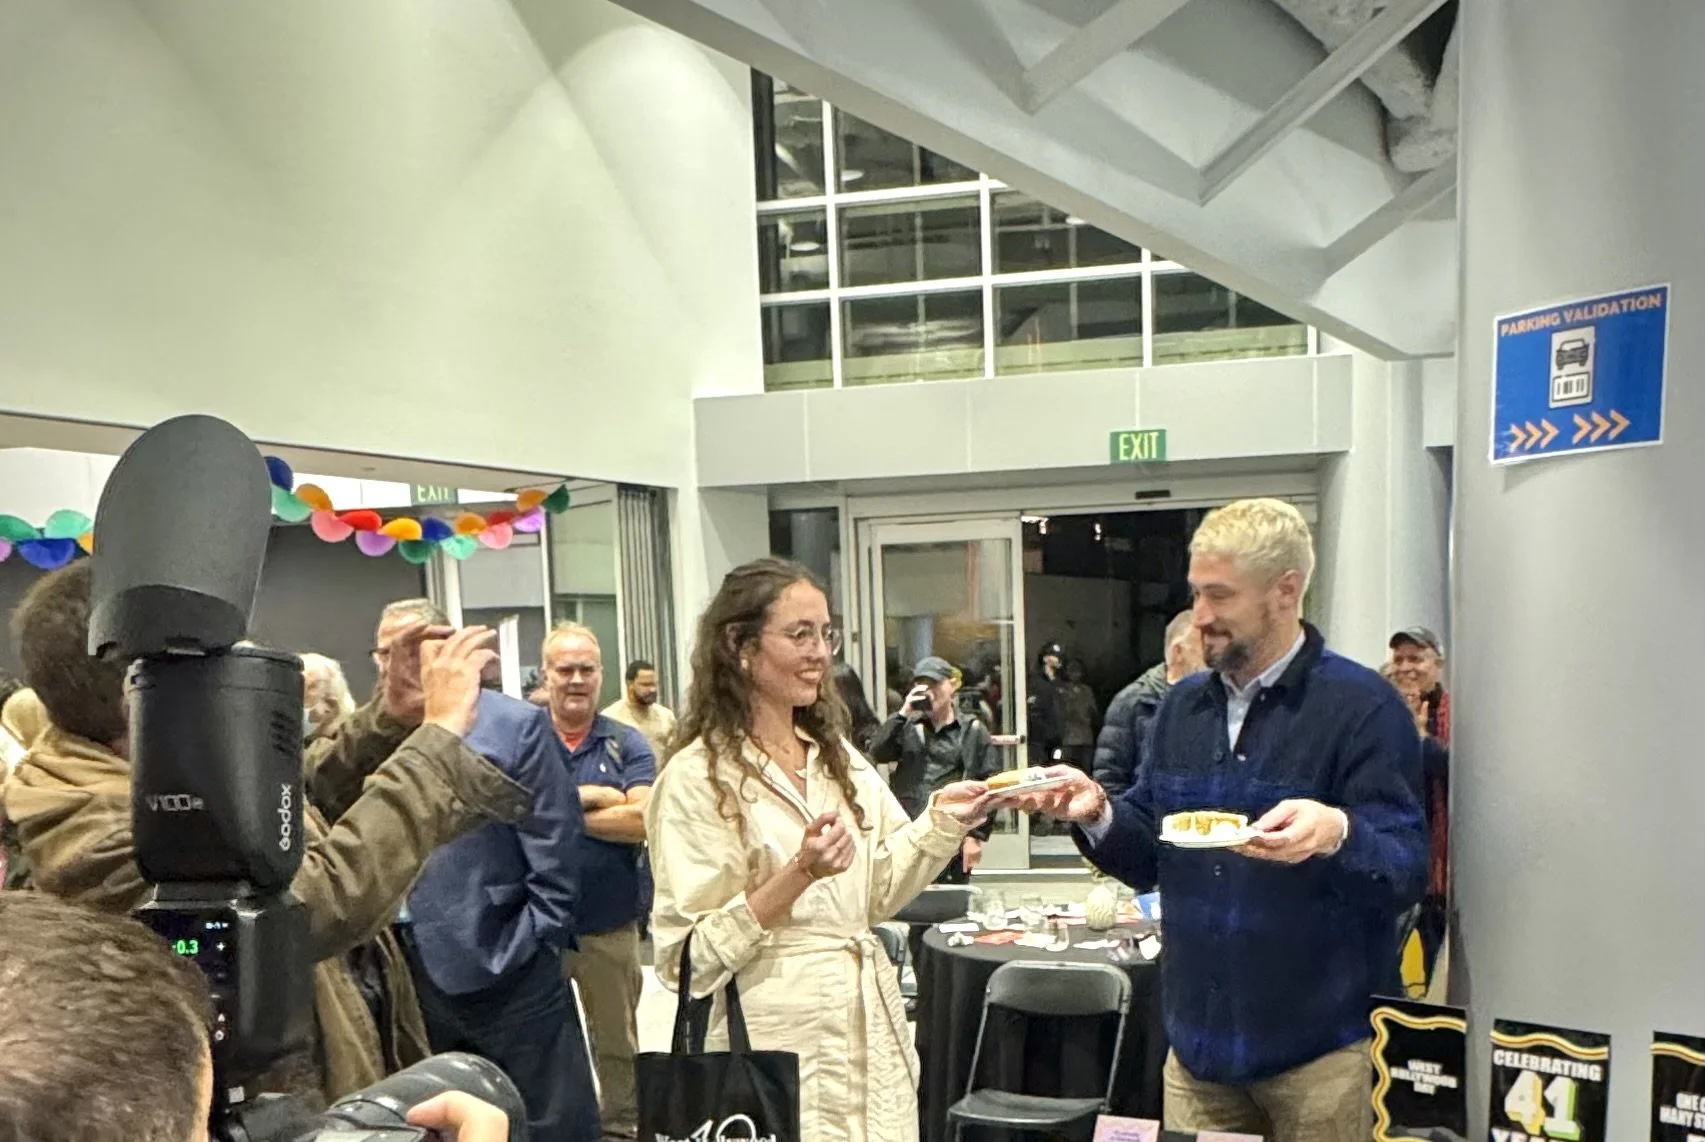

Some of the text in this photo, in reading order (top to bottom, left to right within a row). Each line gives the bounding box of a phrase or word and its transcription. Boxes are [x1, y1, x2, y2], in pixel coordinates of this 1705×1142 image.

[1501, 293, 1662, 337] PARKING VALIDATION
[1119, 431, 1159, 461] EXIT
[277, 783, 292, 851] Godox
[1493, 1048, 1603, 1082] CELEBRATING
[1504, 1069, 1581, 1141] 41
